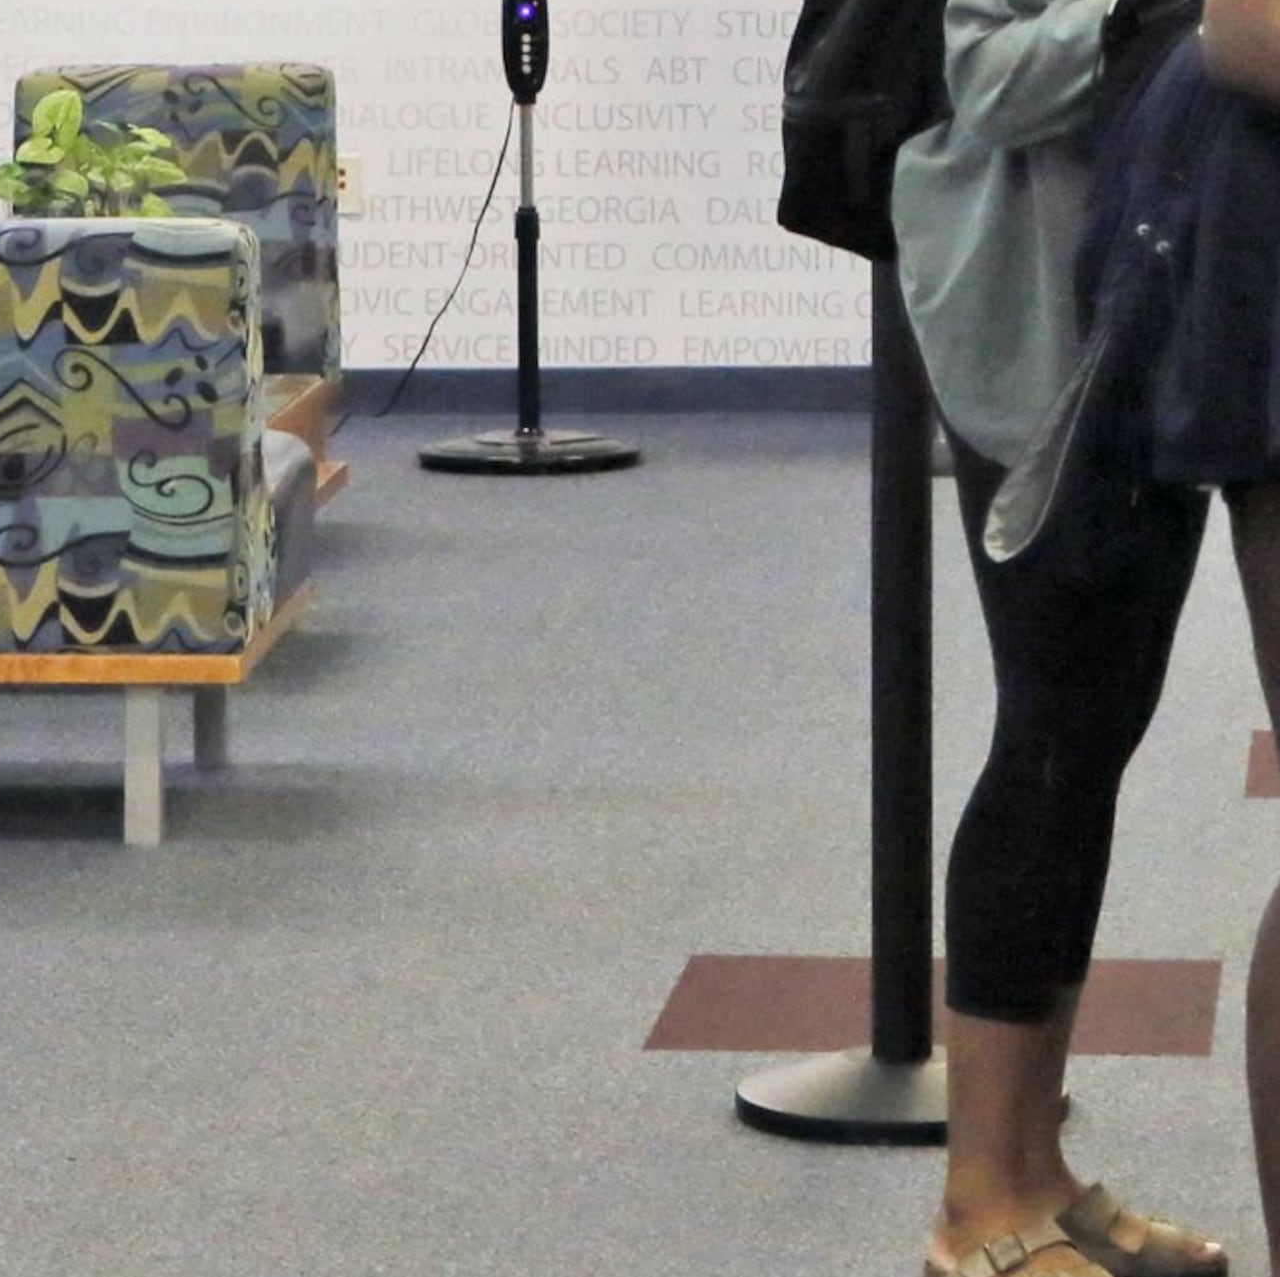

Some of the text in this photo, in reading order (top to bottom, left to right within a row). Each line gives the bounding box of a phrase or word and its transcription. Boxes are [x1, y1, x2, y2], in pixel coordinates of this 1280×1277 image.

[556, 9, 691, 38] SOCIETY
[646, 56, 708, 85] ABT
[556, 149, 720, 178] LEARNING
[424, 288, 652, 318] ENGAEMENT
[679, 289, 843, 318] LEARNING
[683, 335, 850, 364] EMPOWER
